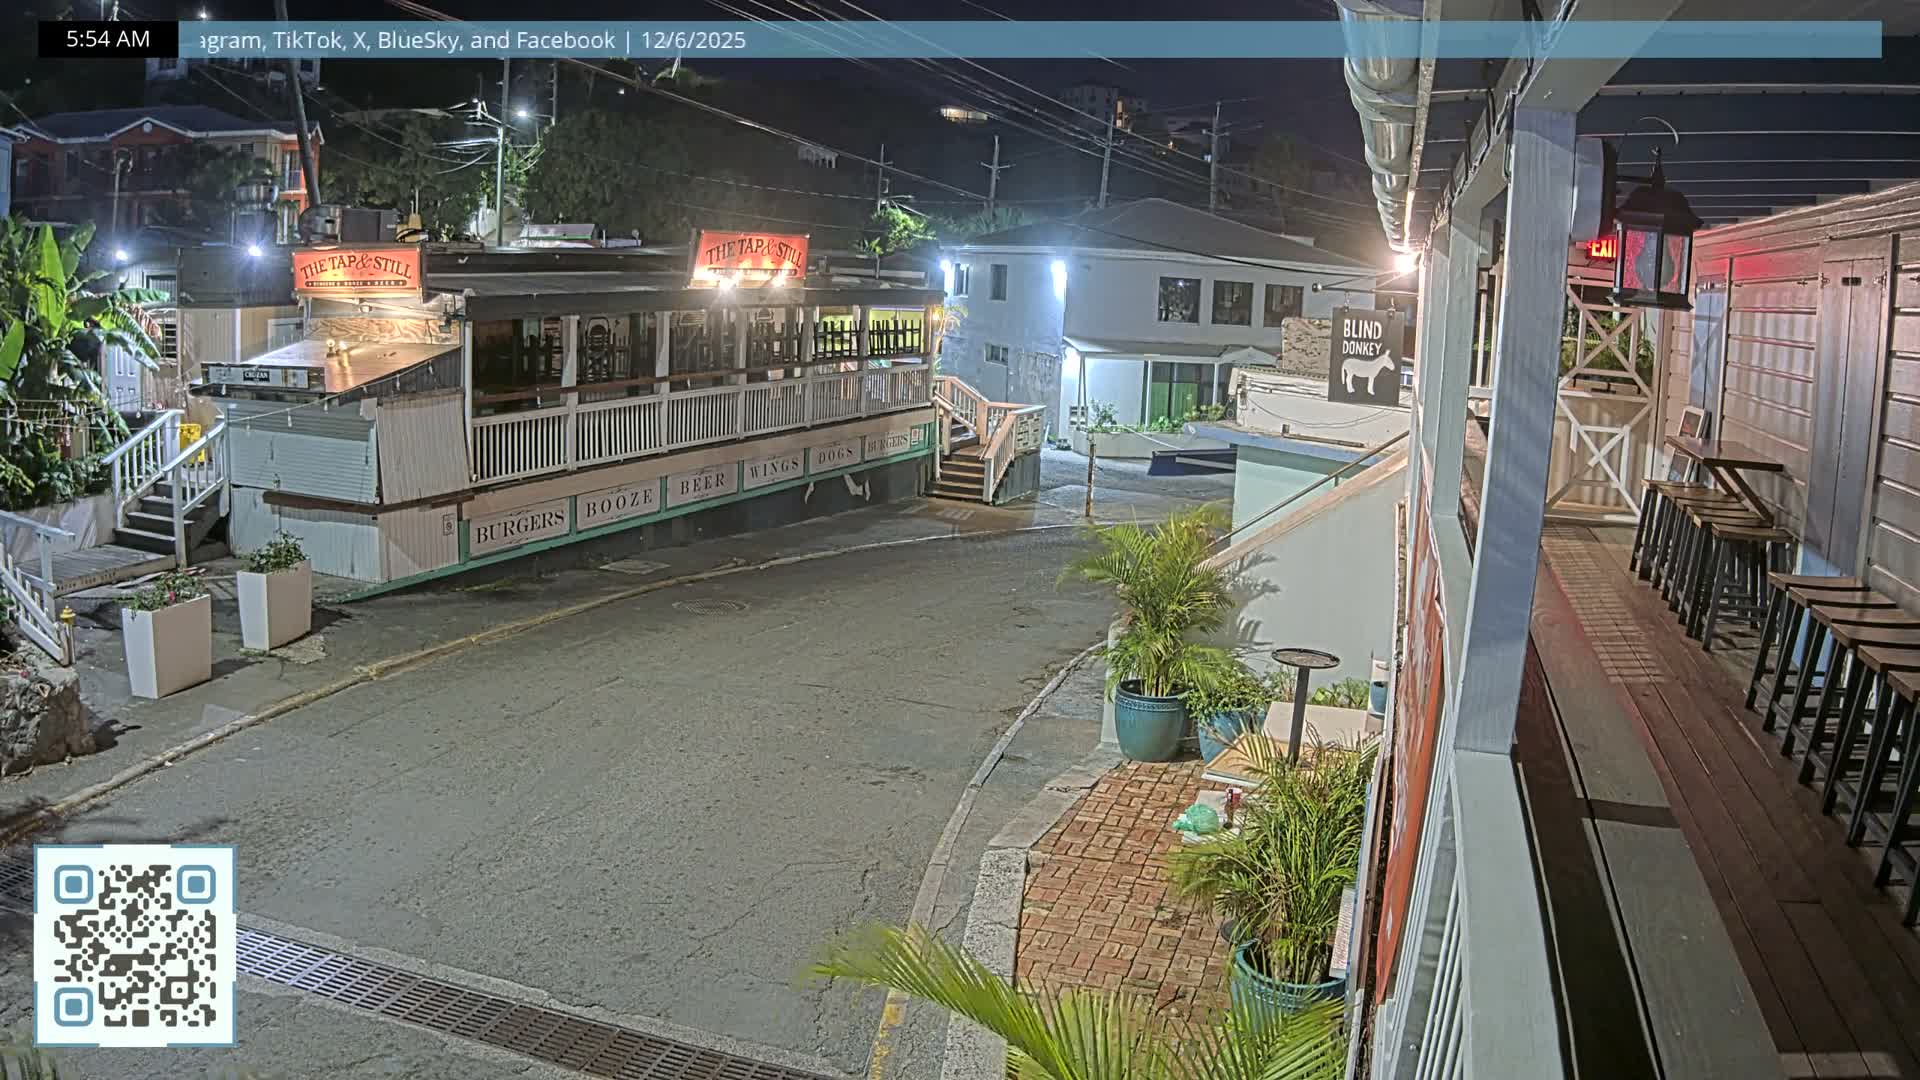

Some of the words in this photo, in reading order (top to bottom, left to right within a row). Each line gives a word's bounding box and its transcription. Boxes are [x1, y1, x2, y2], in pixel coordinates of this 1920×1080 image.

[705, 241, 736, 265] THE
[300, 258, 328, 280] THE
[1343, 318, 1382, 340] BLIND
[1342, 340, 1382, 356] DONKEY
[867, 433, 909, 452] BURGERS
[818, 446, 853, 465] DOGS
[750, 457, 799, 479] WINGS
[680, 471, 726, 496] BEER
[586, 488, 653, 518] BOOZE
[476, 509, 565, 544] BURGERS
